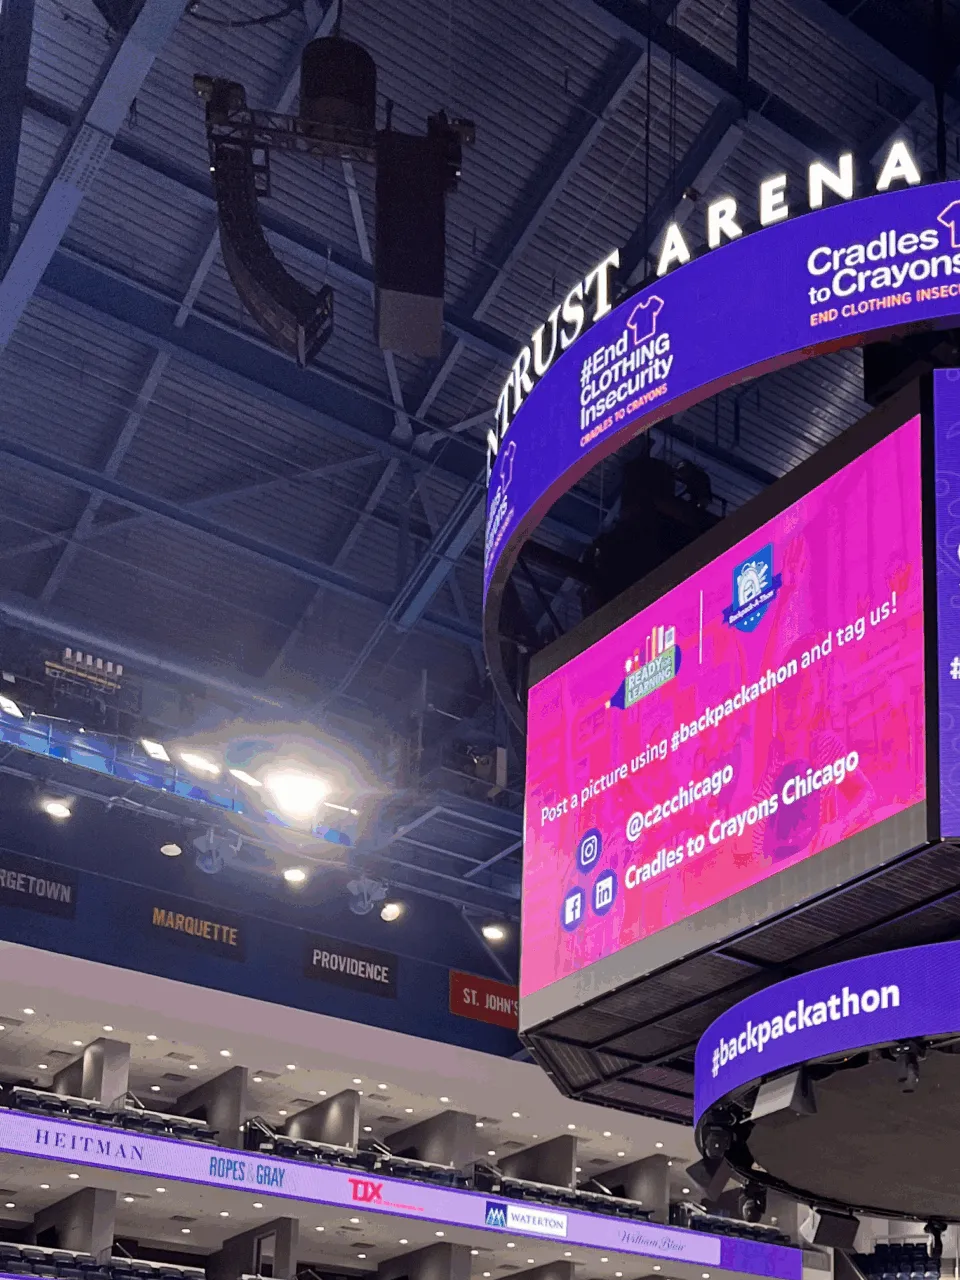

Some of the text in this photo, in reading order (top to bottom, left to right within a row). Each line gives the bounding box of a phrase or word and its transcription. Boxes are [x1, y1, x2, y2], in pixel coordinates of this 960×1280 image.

[656, 142, 922, 277] ARENA
[807, 228, 939, 276] Cradles
[810, 308, 837, 327] END
[840, 292, 912, 320] CLOTHING
[580, 329, 628, 388] #End
[580, 332, 670, 406] CLOTHING
[580, 354, 674, 430] Insecurity
[580, 382, 668, 447] CRADLES TO CRAYONS
[628, 656, 663, 690] READY
[540, 590, 898, 827] Post a picture using #backpackathon and tag us!
[624, 750, 859, 890] Cradles to Crayons Chicago
[625, 763, 734, 842] @c2cchicago
[152, 906, 238, 946] MARQUETTE
[312, 948, 390, 984] PROVIDENCE
[462, 987, 480, 1007] ST.
[711, 984, 900, 1077] #backpackathon
[35, 1128, 145, 1161] HEITMAN
[209, 1156, 287, 1188] ROPES GRAY
[511, 1213, 564, 1230] WATERTON
